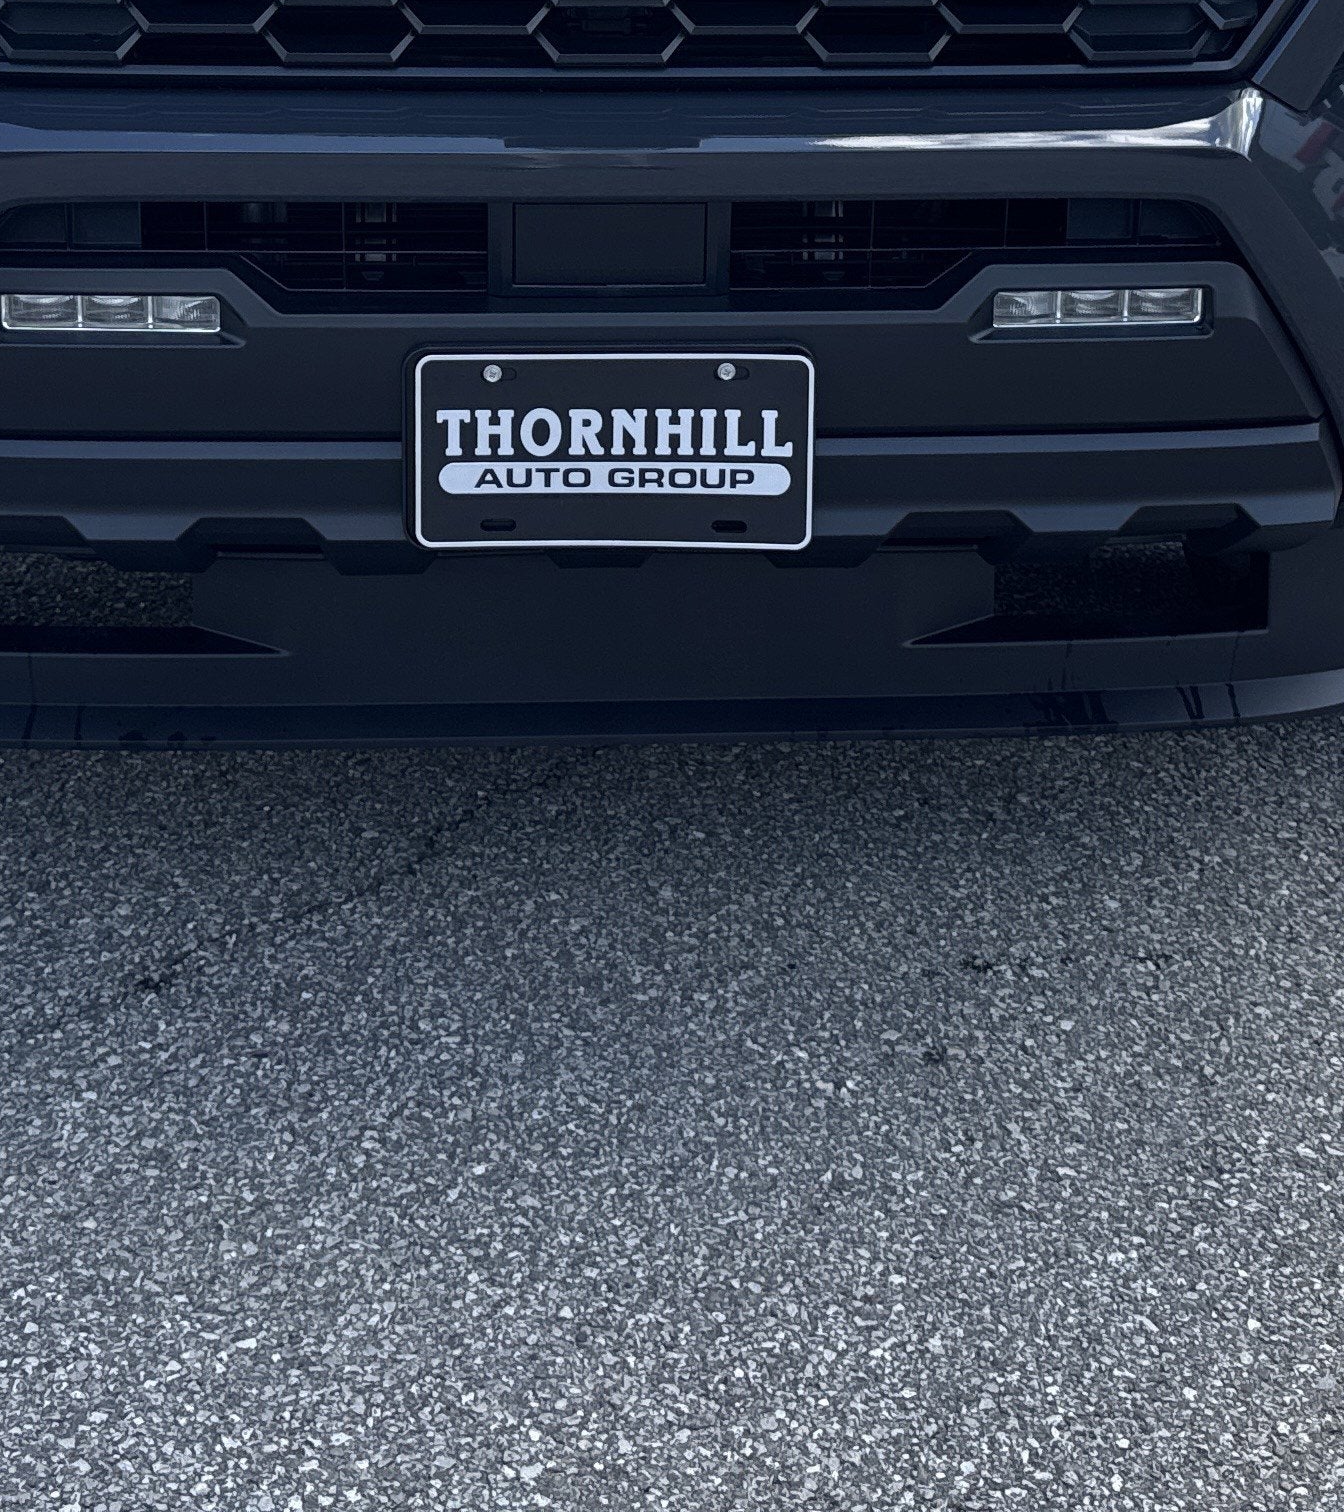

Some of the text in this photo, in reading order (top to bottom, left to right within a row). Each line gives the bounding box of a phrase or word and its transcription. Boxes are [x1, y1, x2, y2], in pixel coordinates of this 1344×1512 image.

[436, 408, 793, 458] THORNHILL
[475, 467, 755, 489] AUTO GROUP
